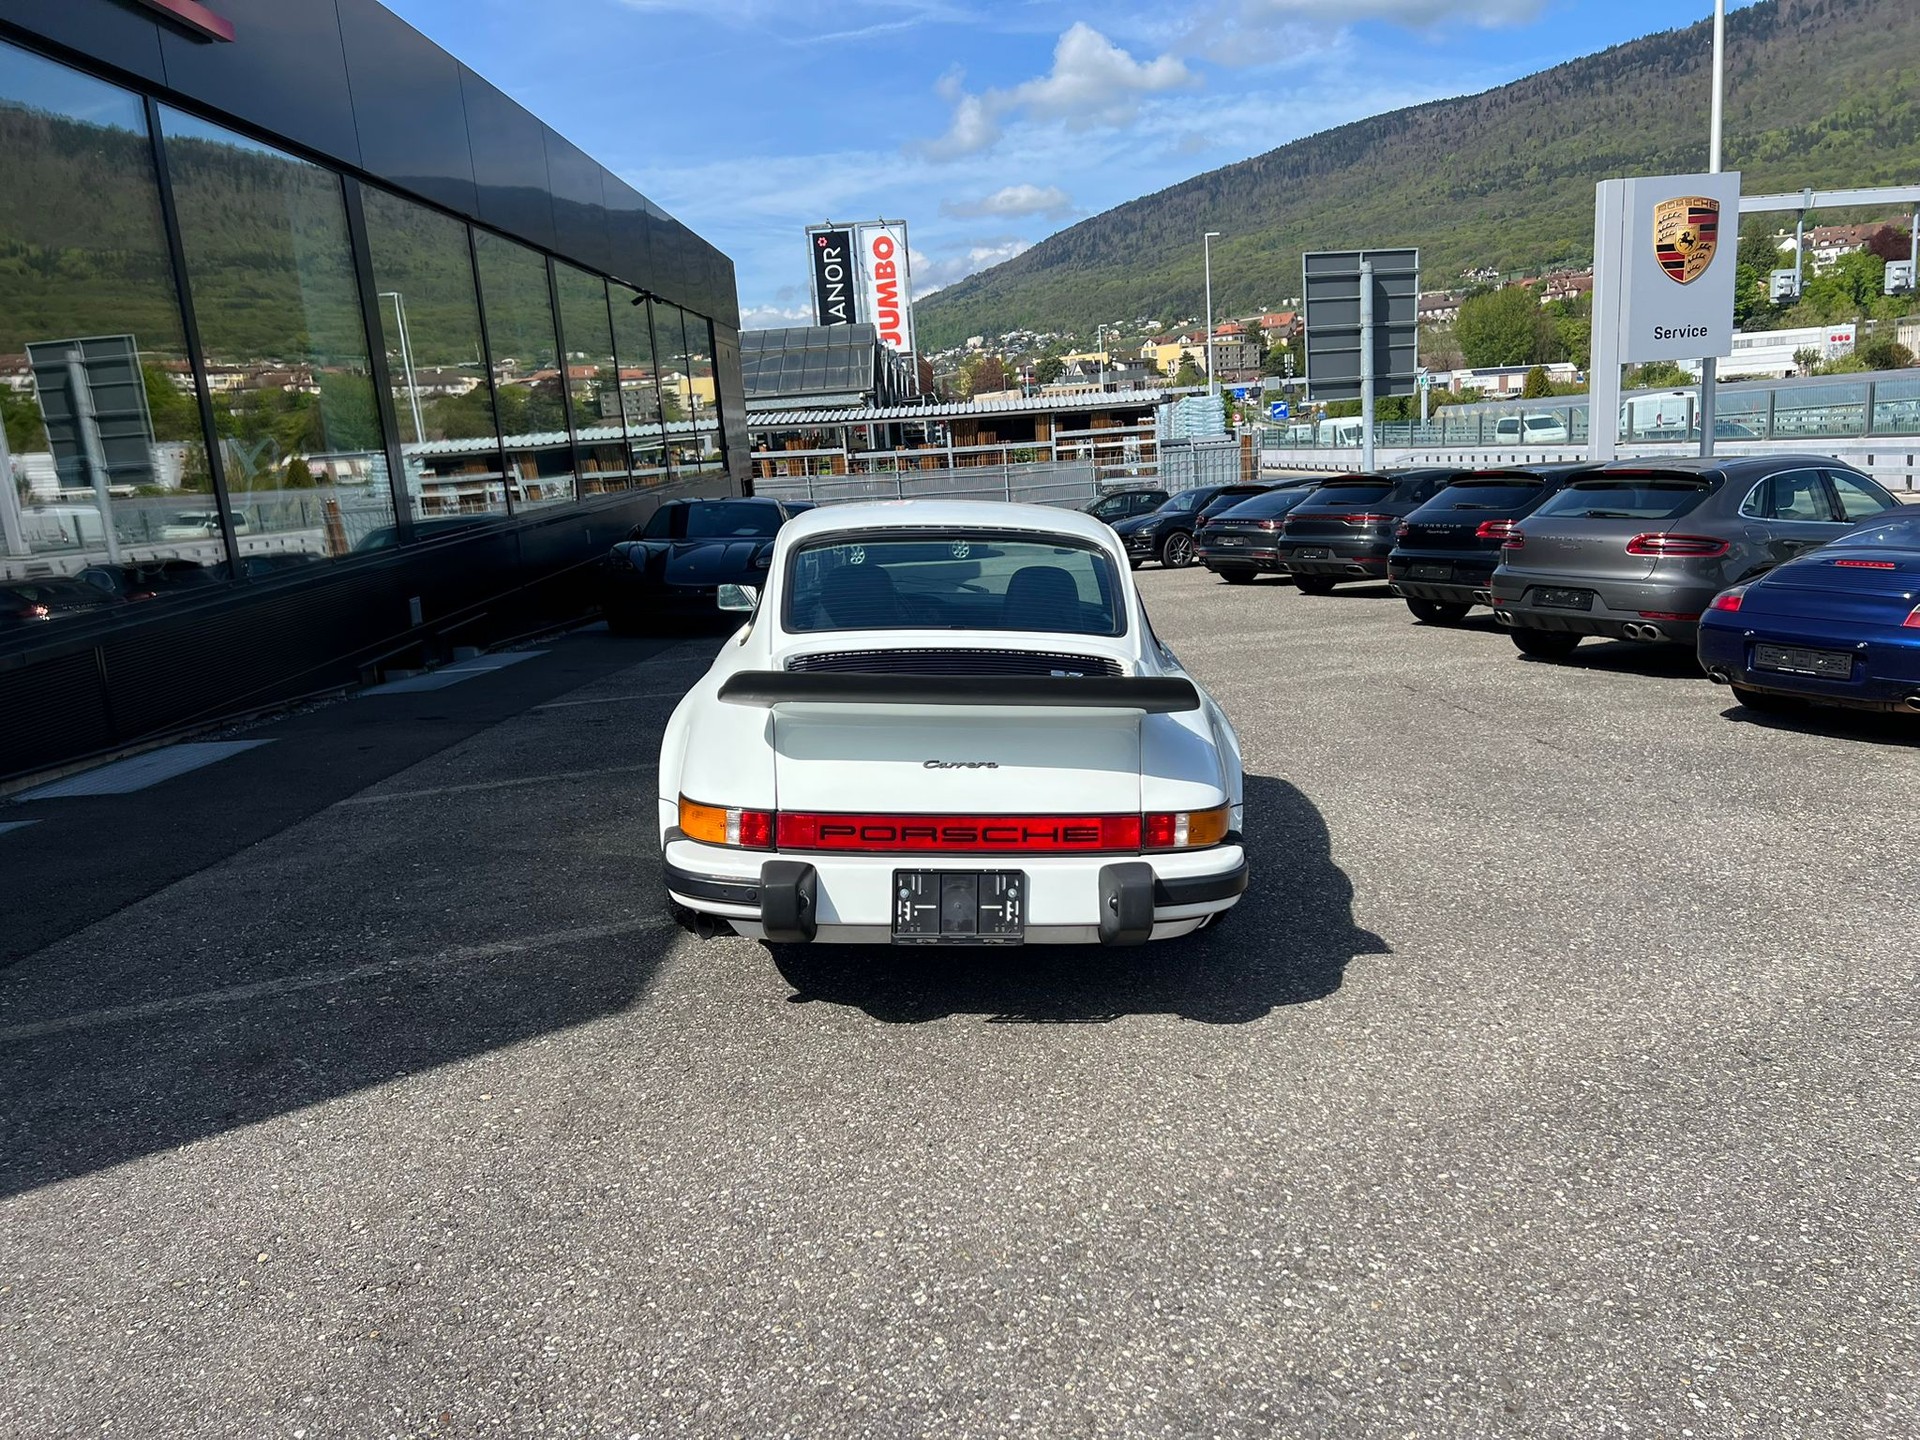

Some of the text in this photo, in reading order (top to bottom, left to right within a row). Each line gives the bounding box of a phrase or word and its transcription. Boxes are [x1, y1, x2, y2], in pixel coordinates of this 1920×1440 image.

[1659, 199, 1718, 212] PORSCHE
[823, 246, 847, 326] ANOR
[872, 236, 902, 346] JUMBO
[1653, 324, 1708, 340] Service
[922, 759, 999, 769] Carrera
[820, 826, 1099, 843] PORSCHE
